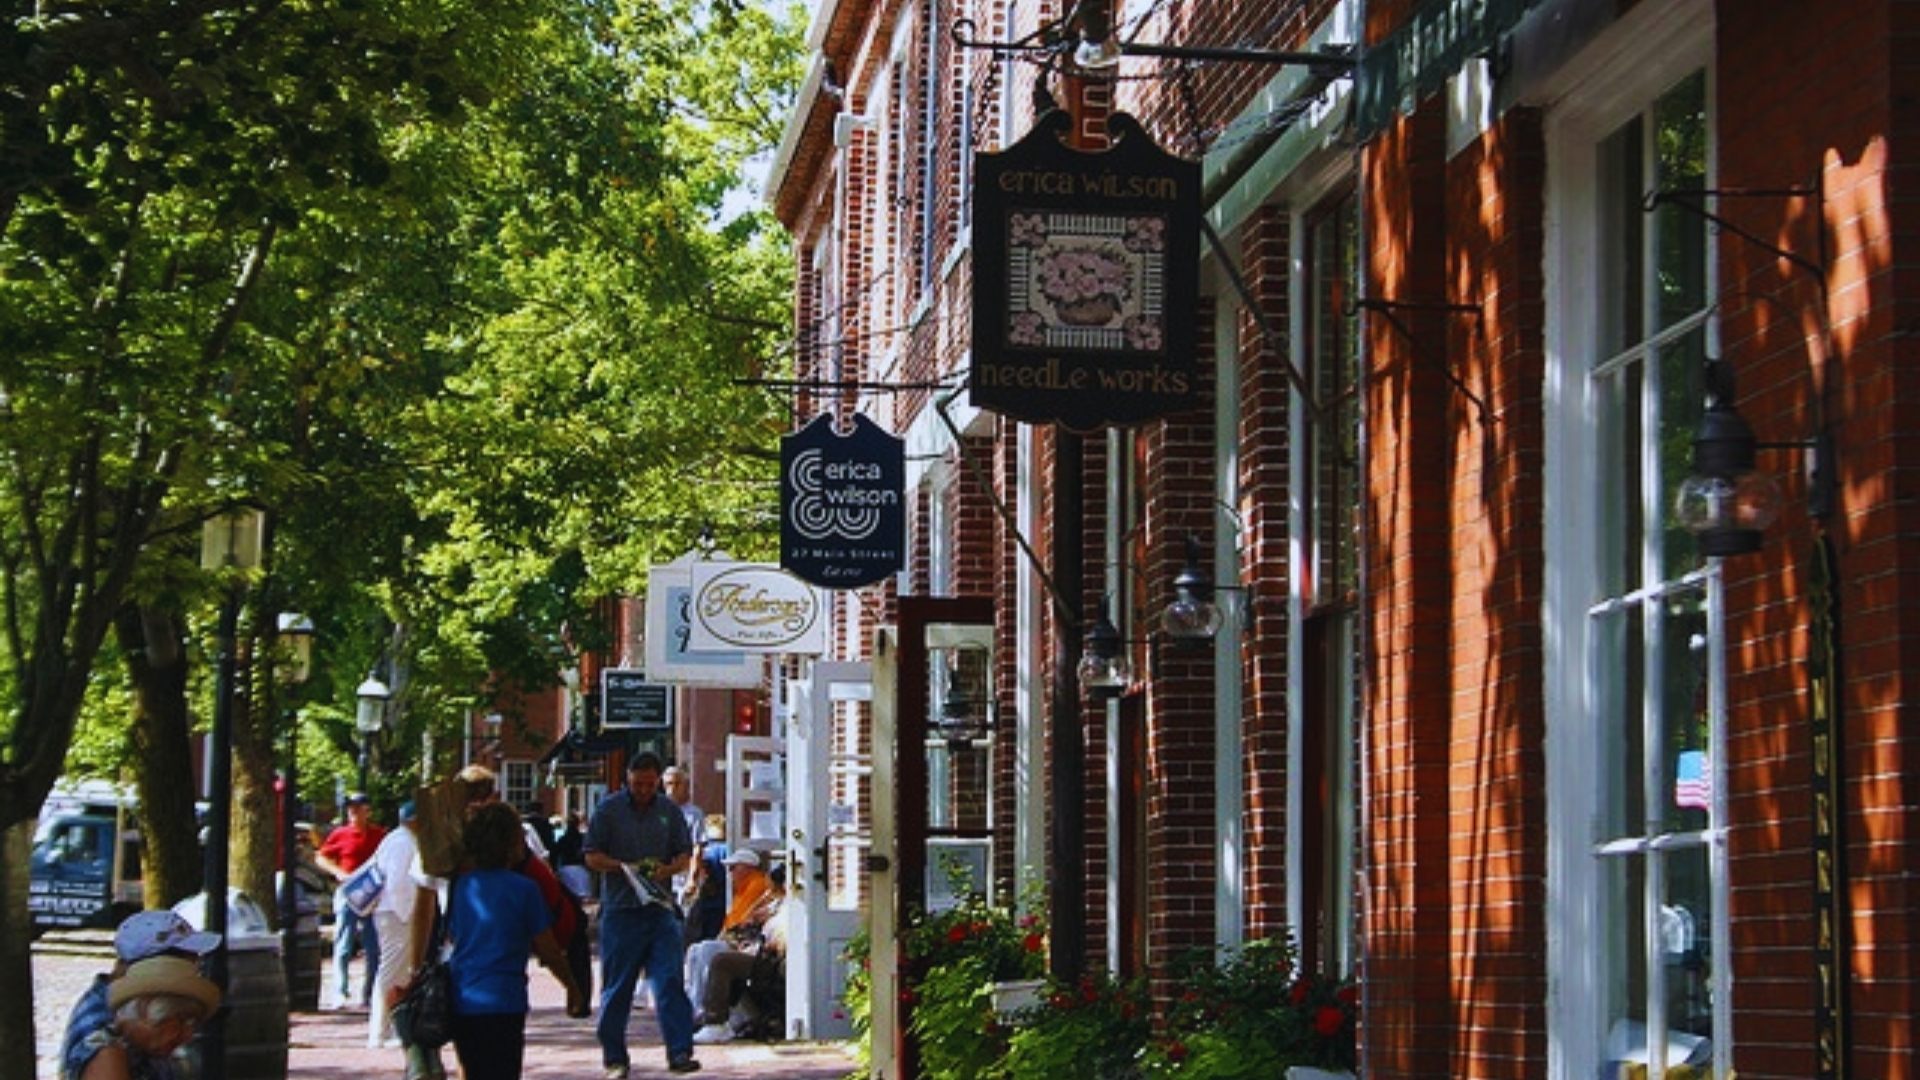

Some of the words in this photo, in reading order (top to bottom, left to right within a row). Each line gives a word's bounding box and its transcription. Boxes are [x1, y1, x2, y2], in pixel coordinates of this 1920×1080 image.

[999, 167, 1074, 195] erica
[1097, 364, 1190, 395] works
[825, 460, 881, 480] erica
[825, 484, 898, 505] wilson
